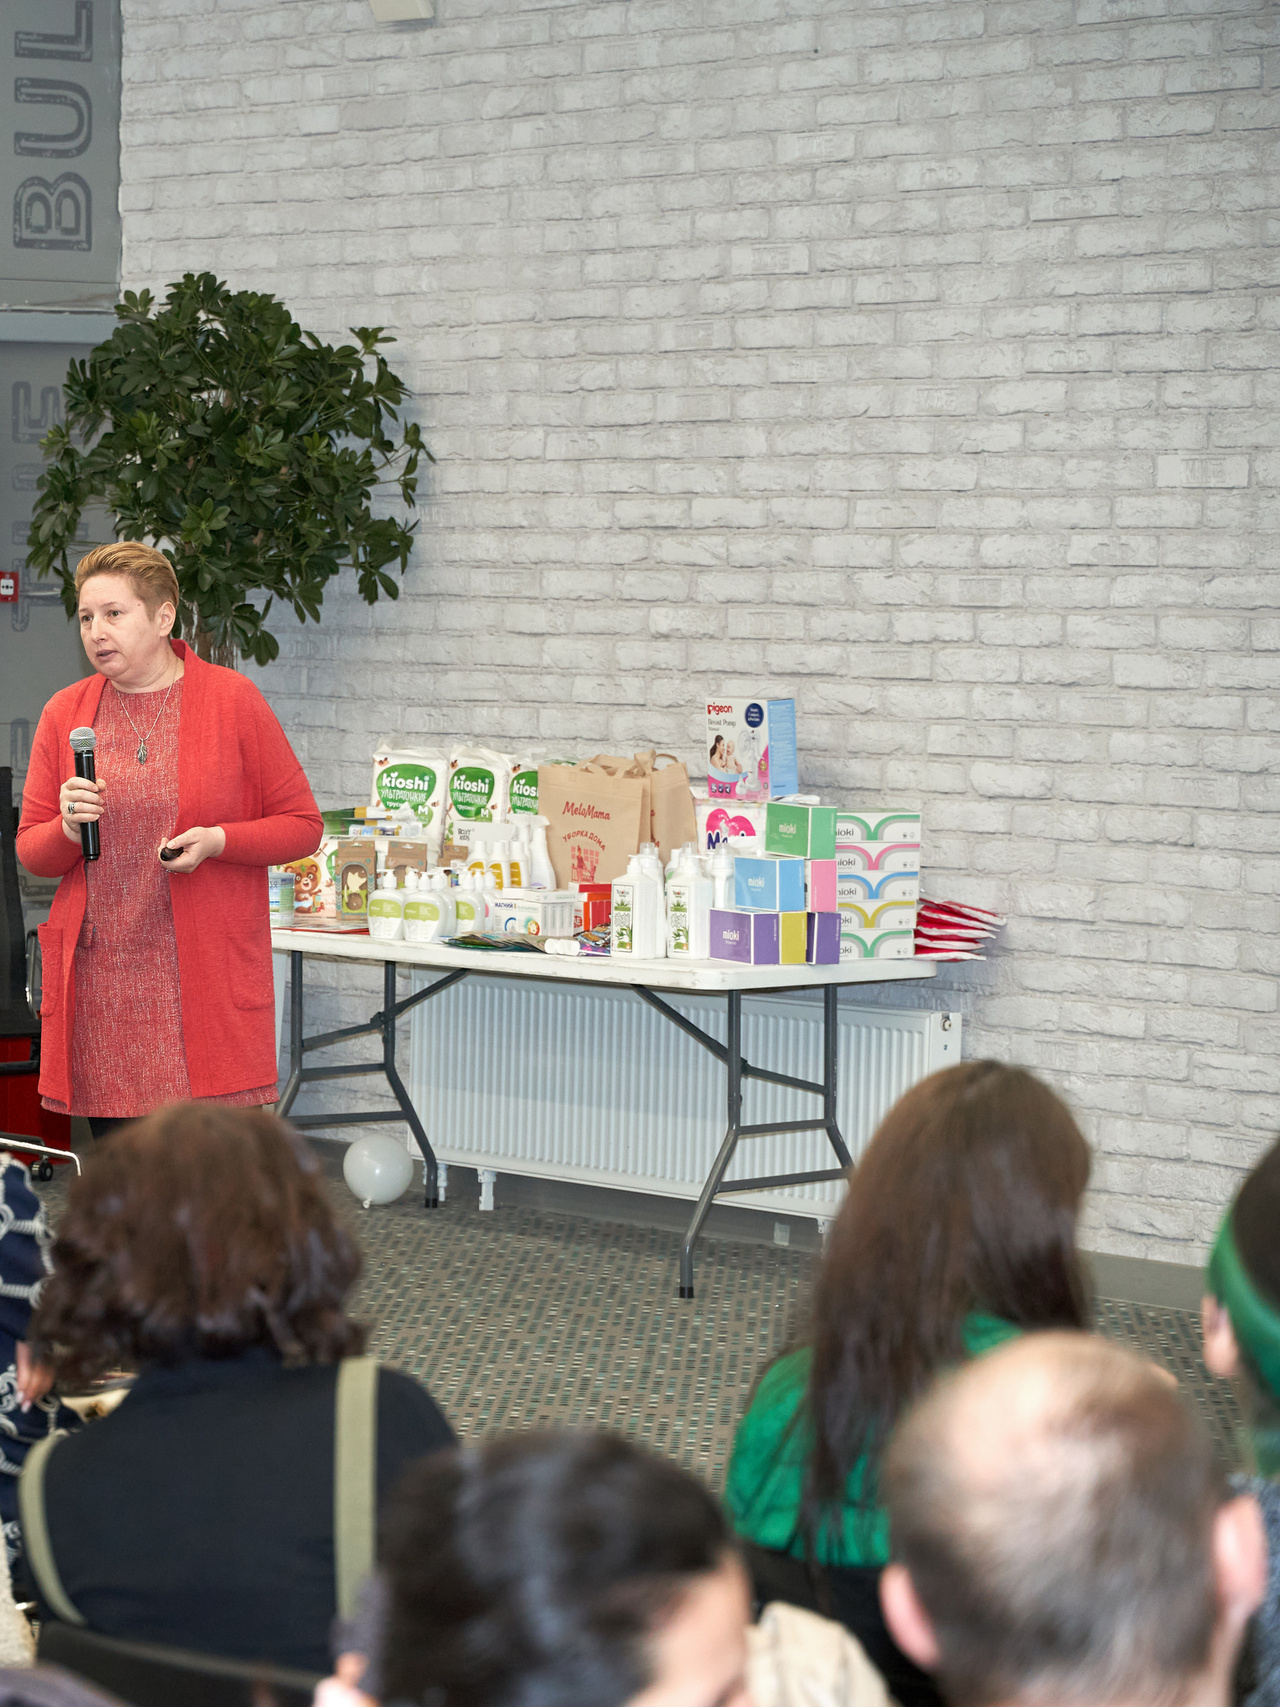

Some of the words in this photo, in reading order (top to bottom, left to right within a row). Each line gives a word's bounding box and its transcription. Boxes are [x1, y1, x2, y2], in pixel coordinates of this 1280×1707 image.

[707, 702, 733, 715] pigeon
[382, 771, 429, 791] kioshi
[453, 774, 489, 794] kioshi
[512, 778, 539, 798] kios
[562, 801, 611, 821] MeloMama
[779, 823, 797, 834] mioki
[562, 830, 589, 843] УБОРКА
[588, 832, 606, 851] ДОМА
[748, 876, 765, 888] mioki
[723, 930, 740, 941] mioki
